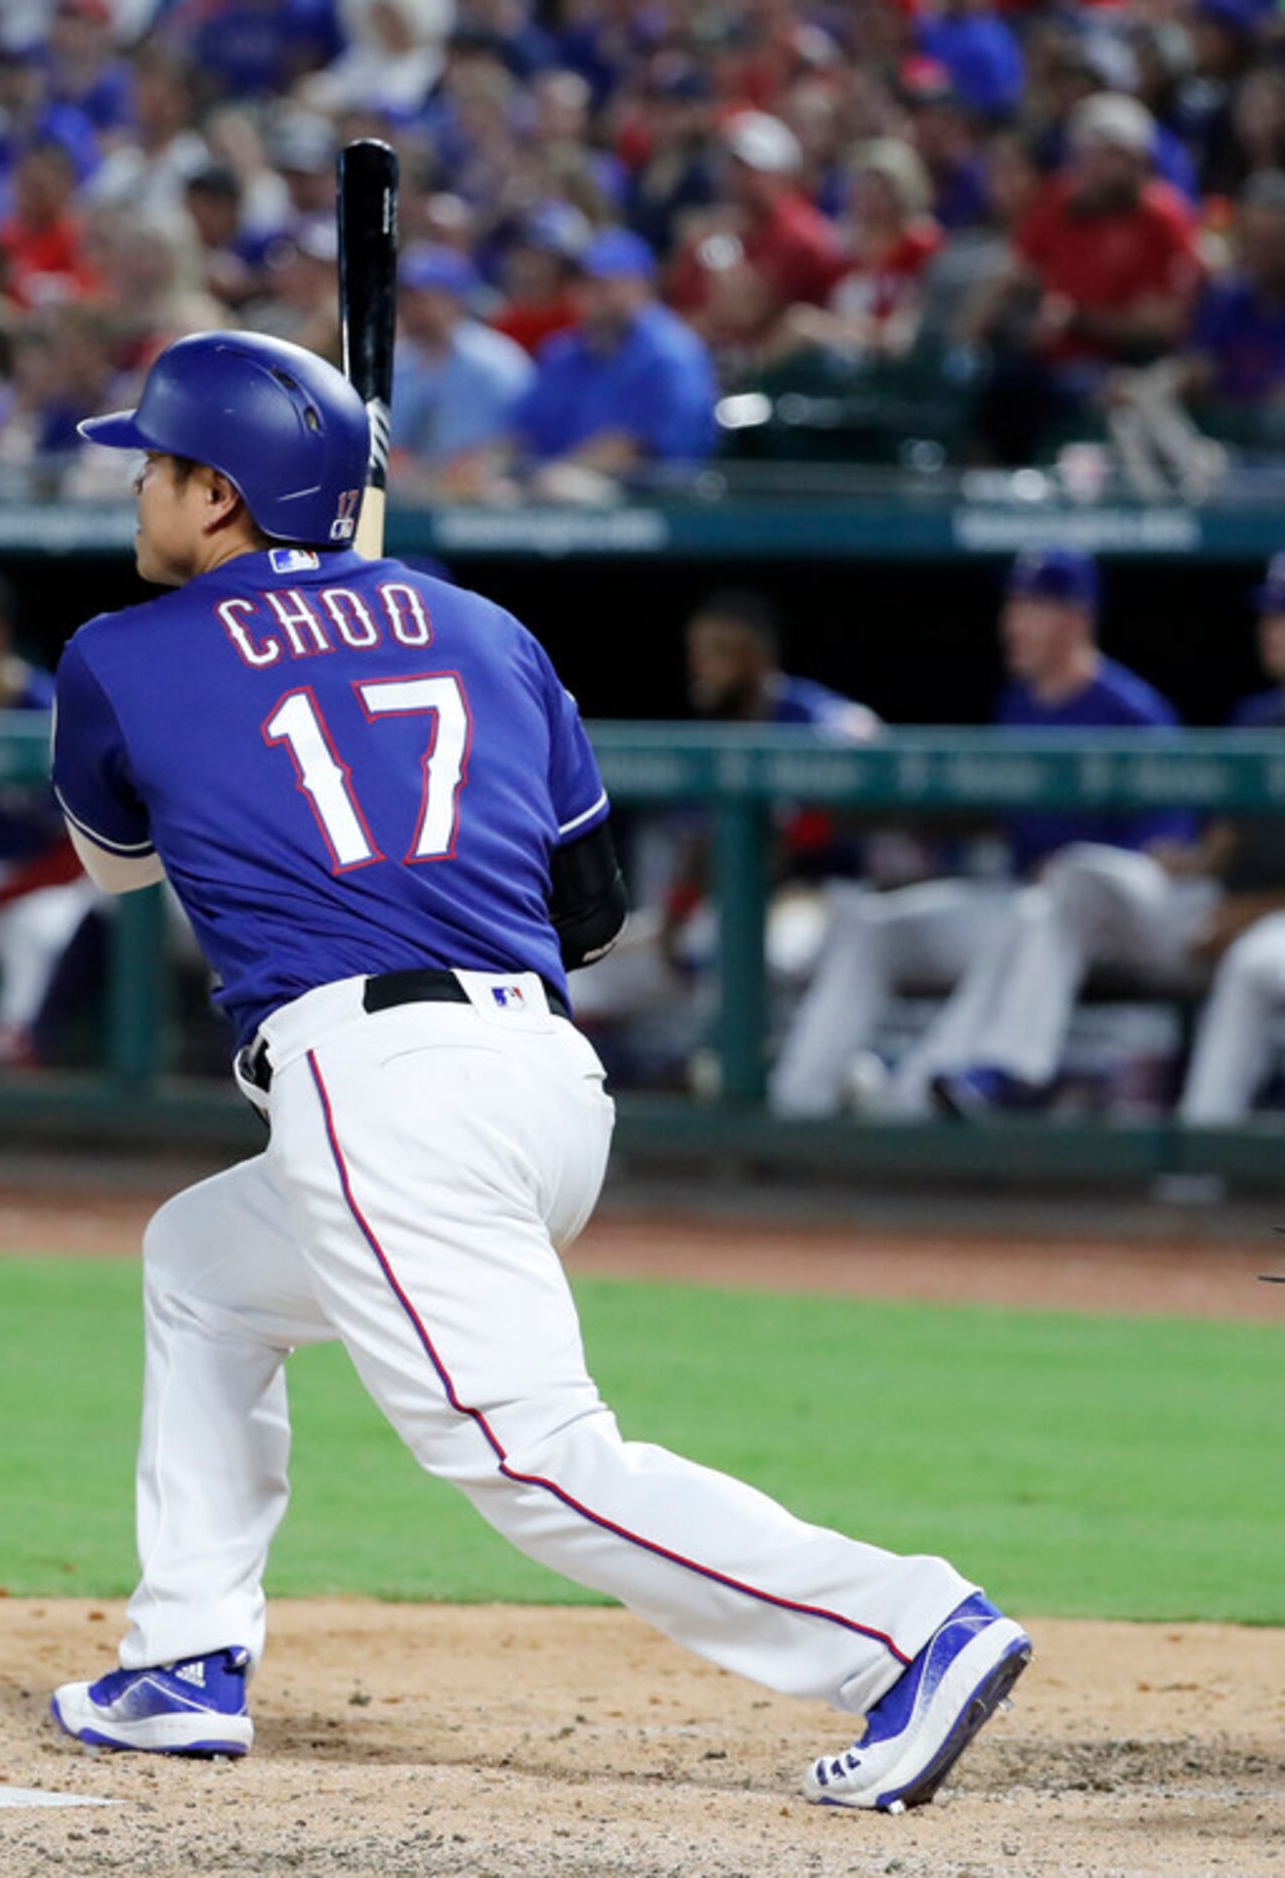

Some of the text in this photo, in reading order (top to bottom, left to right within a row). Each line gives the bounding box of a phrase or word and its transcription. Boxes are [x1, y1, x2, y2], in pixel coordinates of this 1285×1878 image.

[337, 489, 359, 519] 17
[215, 582, 434, 668] CHOO
[260, 670, 471, 875] 17
